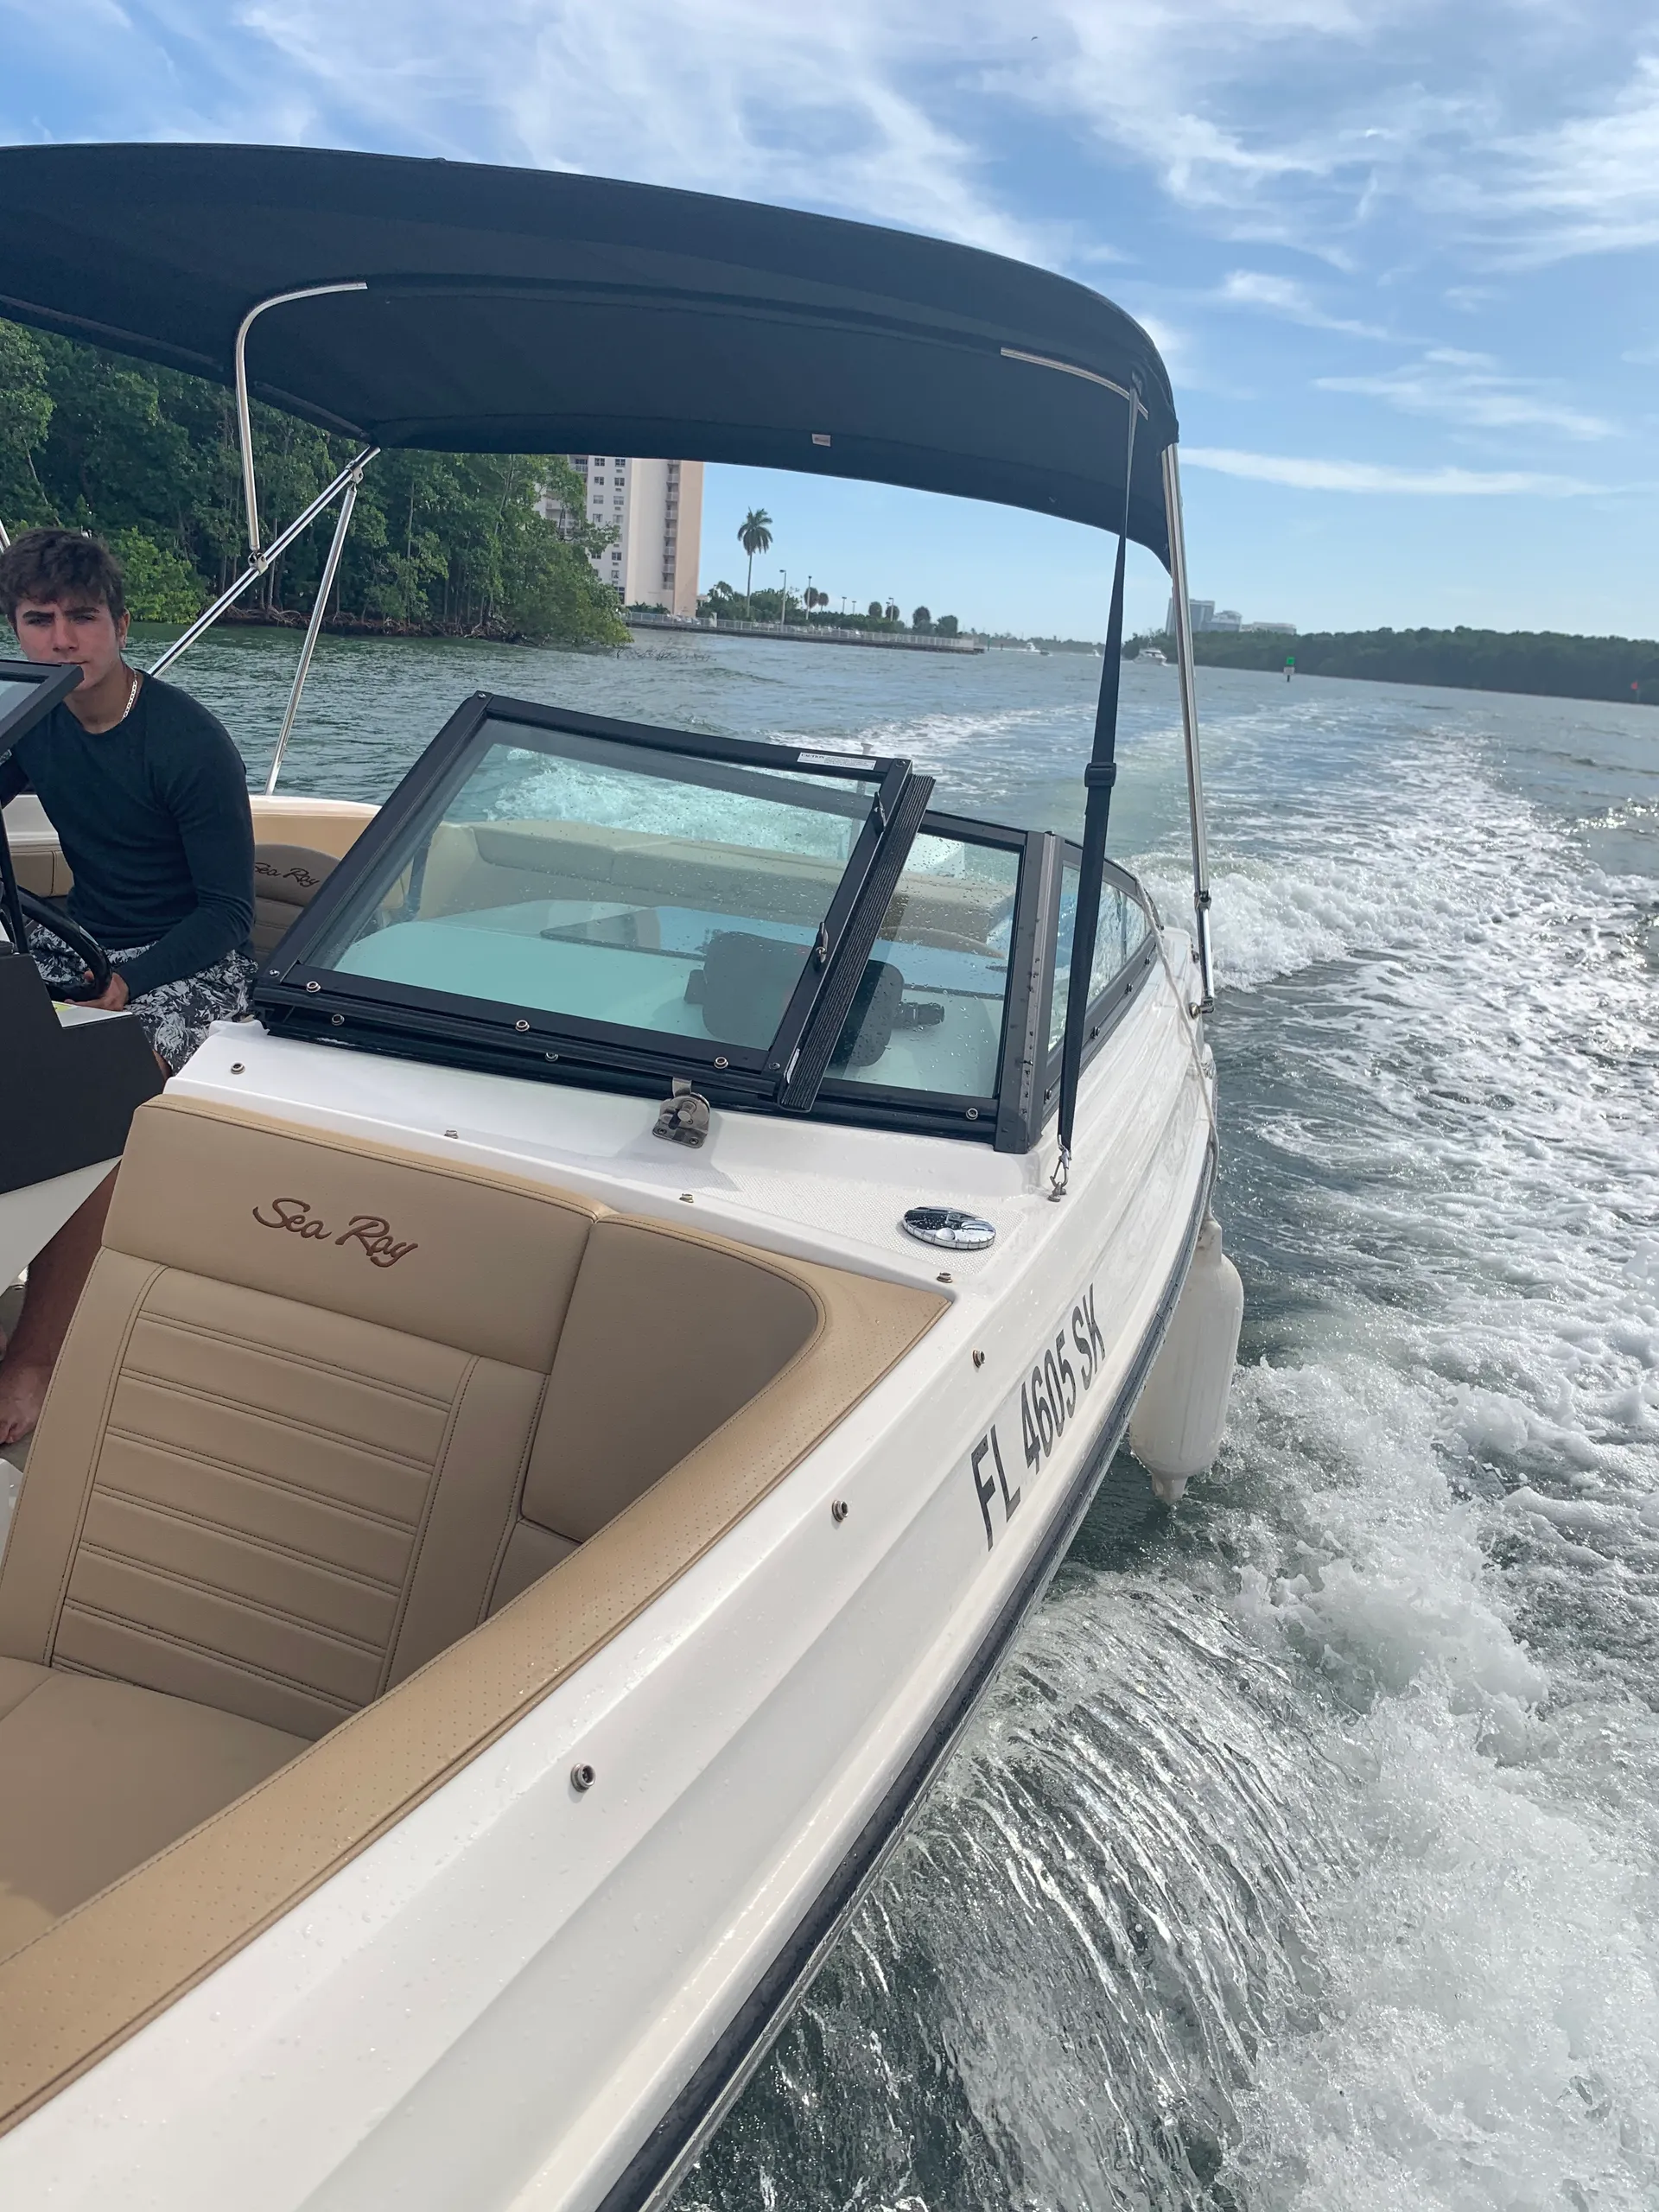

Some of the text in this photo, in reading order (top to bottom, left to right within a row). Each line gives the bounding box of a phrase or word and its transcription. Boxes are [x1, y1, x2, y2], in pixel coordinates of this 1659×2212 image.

[283, 868, 320, 887] Ray
[252, 1198, 418, 1268] Sea Ray
[971, 1282, 1106, 1552] FL 4605 SK
